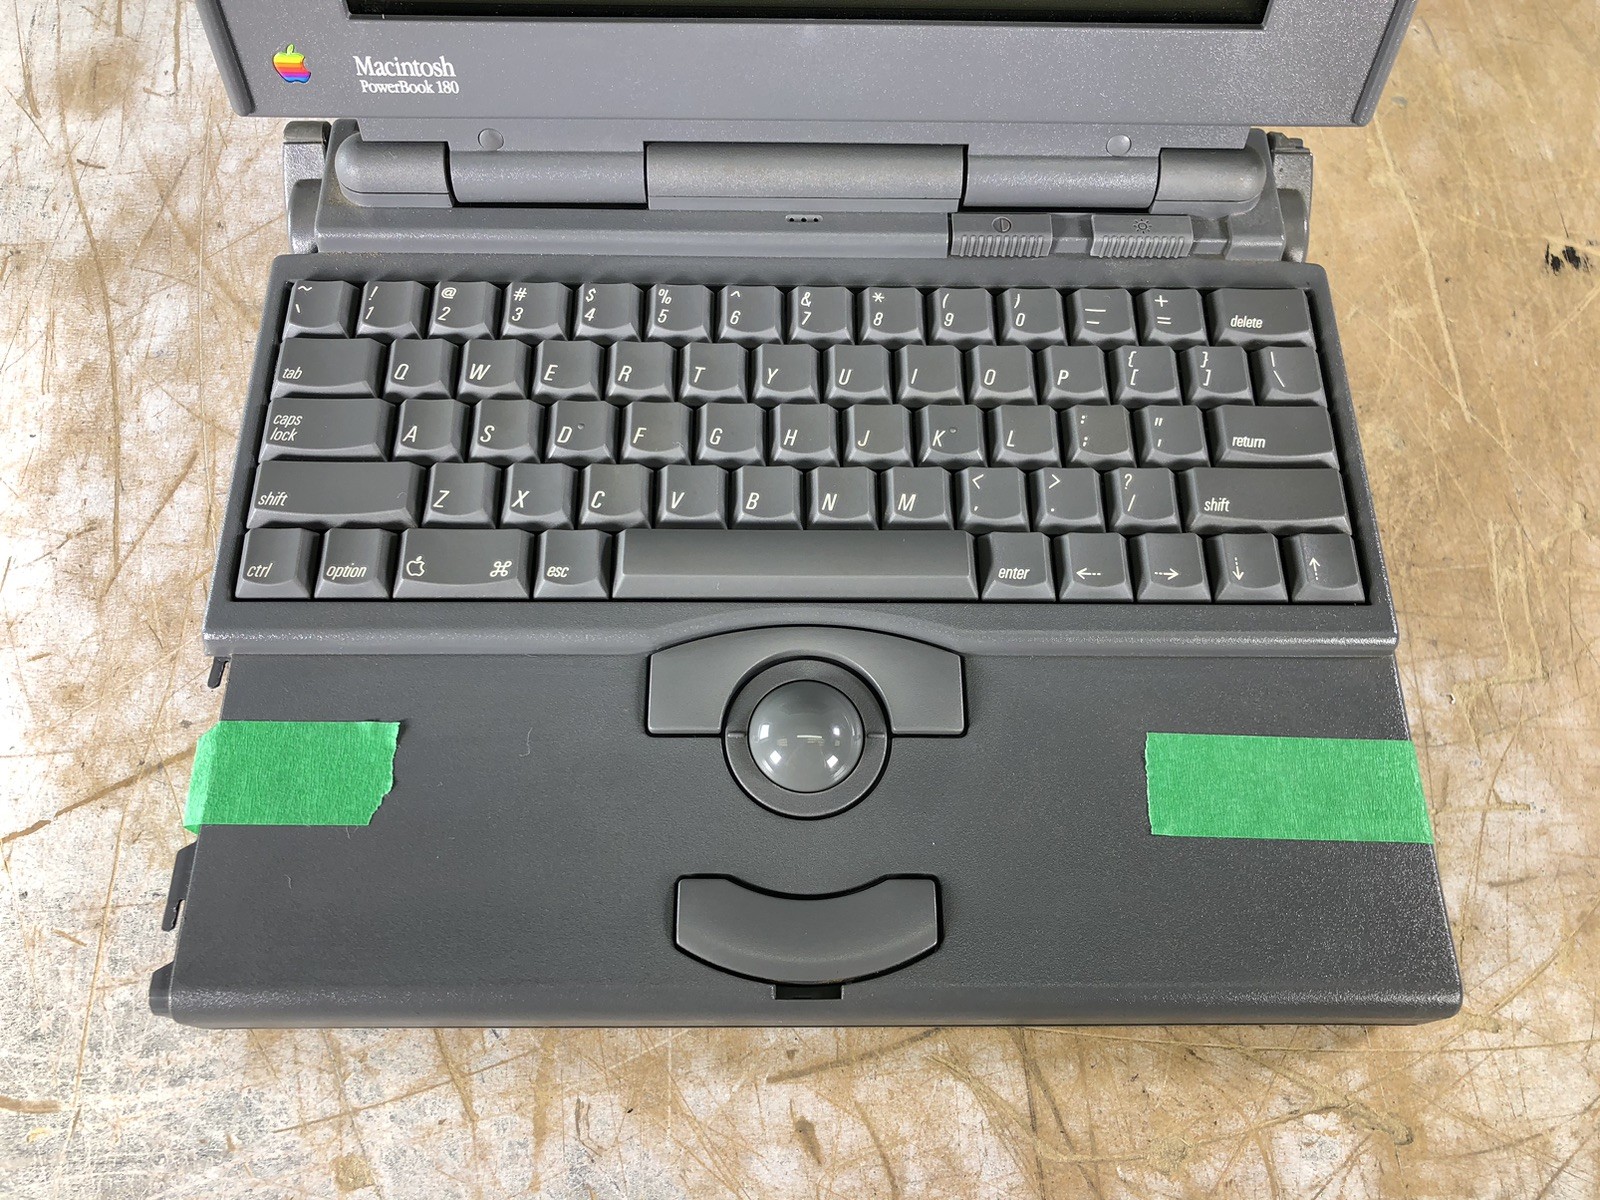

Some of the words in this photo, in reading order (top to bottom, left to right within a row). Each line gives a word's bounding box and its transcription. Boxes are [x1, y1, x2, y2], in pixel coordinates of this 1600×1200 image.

[353, 55, 456, 77] Macintosh
[359, 80, 435, 94] PowerBook
[436, 80, 460, 94] 180
[365, 306, 374, 319] 1
[438, 306, 450, 320] 2
[512, 307, 523, 321] 3
[585, 308, 596, 321] 4
[658, 309, 669, 323] 5
[730, 311, 741, 324] 6
[802, 311, 811, 325] 7
[874, 312, 883, 326] 8
[944, 313, 954, 326] 9
[1231, 315, 1262, 328] delete
[283, 367, 302, 379] tab
[394, 364, 409, 380] Q
[470, 364, 491, 380] W
[544, 365, 558, 380] E
[618, 366, 632, 382] R
[694, 367, 706, 382] T
[767, 368, 778, 384] Y
[839, 369, 851, 385] U
[1057, 370, 1069, 385] P
[273, 415, 302, 428] caps
[270, 427, 297, 441] lock
[403, 426, 417, 442] A
[480, 425, 494, 442] S
[558, 427, 572, 443] D
[633, 428, 646, 443] F
[710, 428, 722, 444] G
[784, 429, 798, 446] H
[858, 430, 870, 446] J
[933, 430, 945, 447] K
[1006, 430, 1015, 447] L
[1232, 436, 1265, 448] return
[258, 492, 288, 506] shift
[433, 490, 449, 507] Z
[511, 490, 529, 508] X
[591, 491, 605, 508] C
[672, 492, 684, 509] V
[746, 492, 759, 509] B
[822, 493, 837, 511] N
[898, 494, 916, 511] M
[1204, 498, 1230, 512] shift
[247, 562, 273, 577] ctrl
[326, 563, 367, 580] option
[547, 566, 569, 577] esc
[998, 568, 1030, 579] enter
